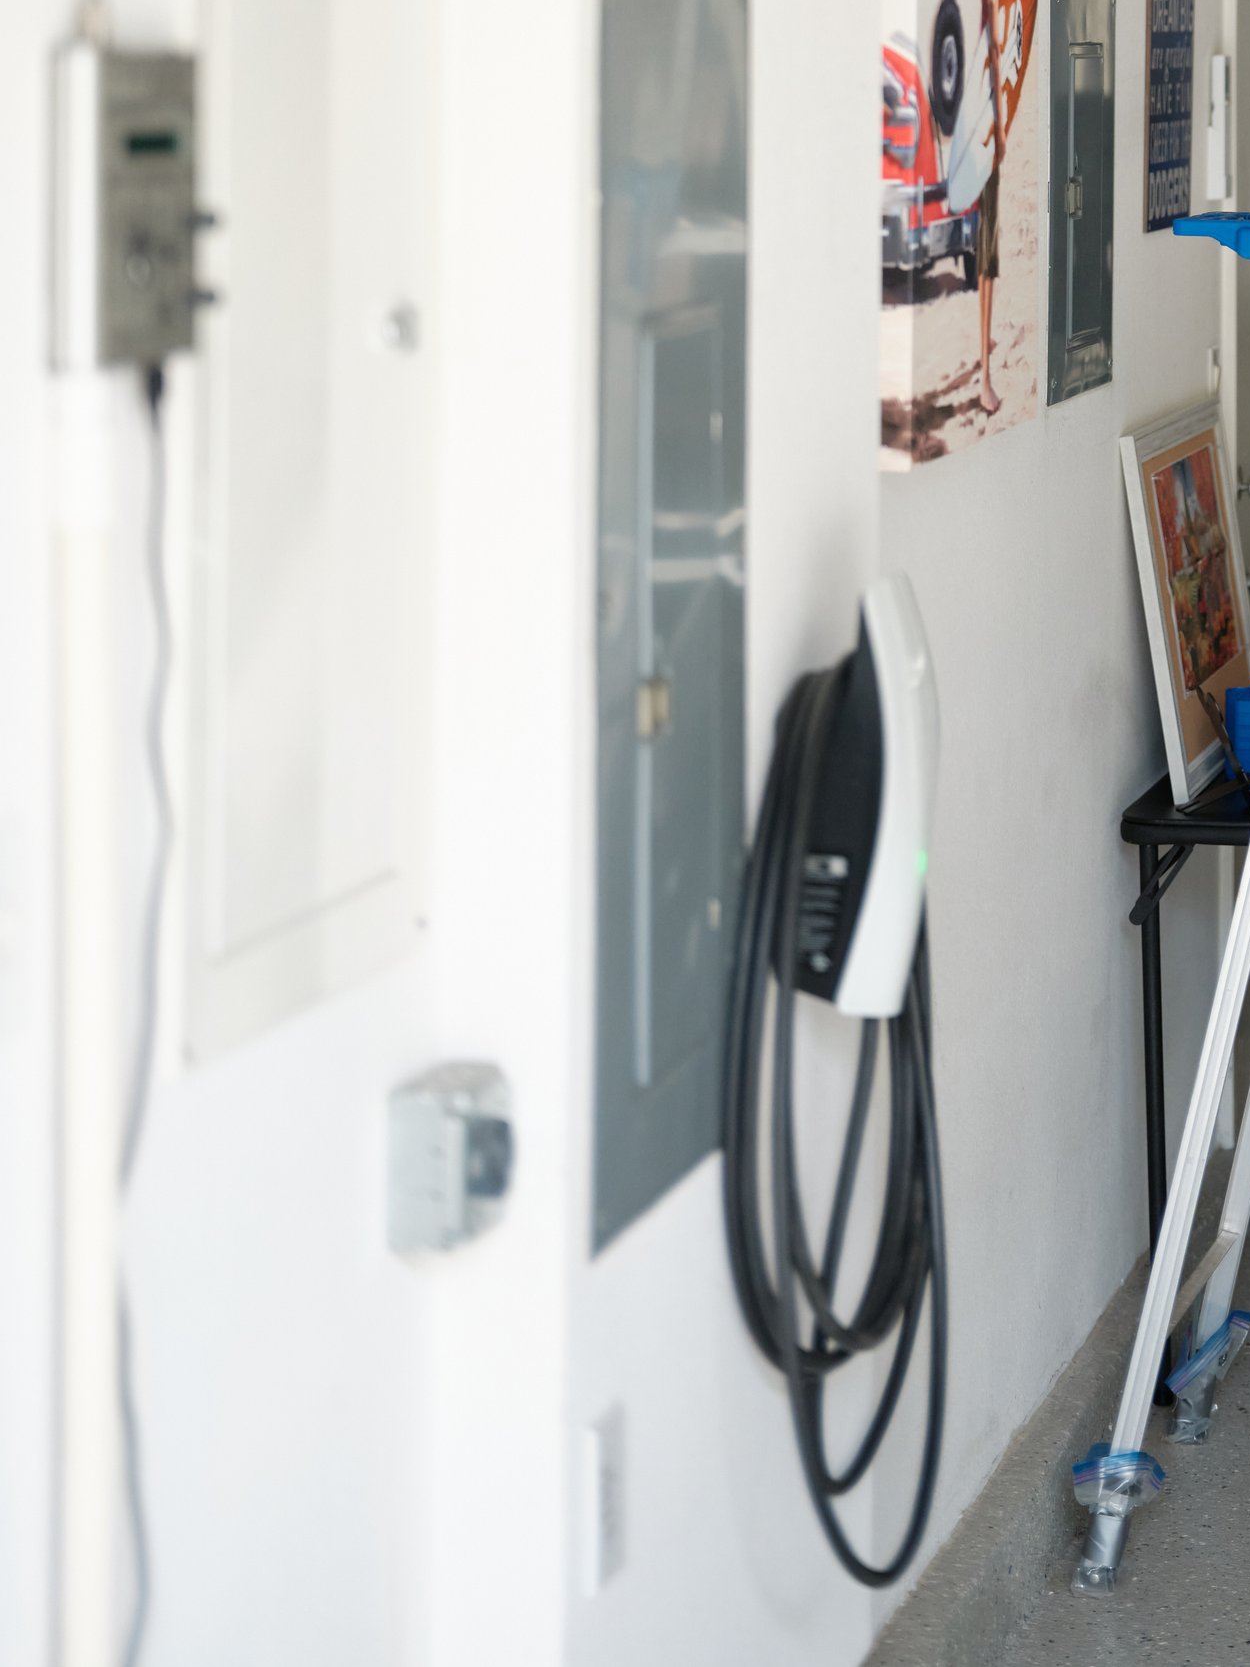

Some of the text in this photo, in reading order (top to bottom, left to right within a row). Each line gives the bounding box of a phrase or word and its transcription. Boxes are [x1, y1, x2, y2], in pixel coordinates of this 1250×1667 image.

[1150, 82, 1191, 116] HAVE FUN
[1148, 167, 1189, 221] DODGERS
